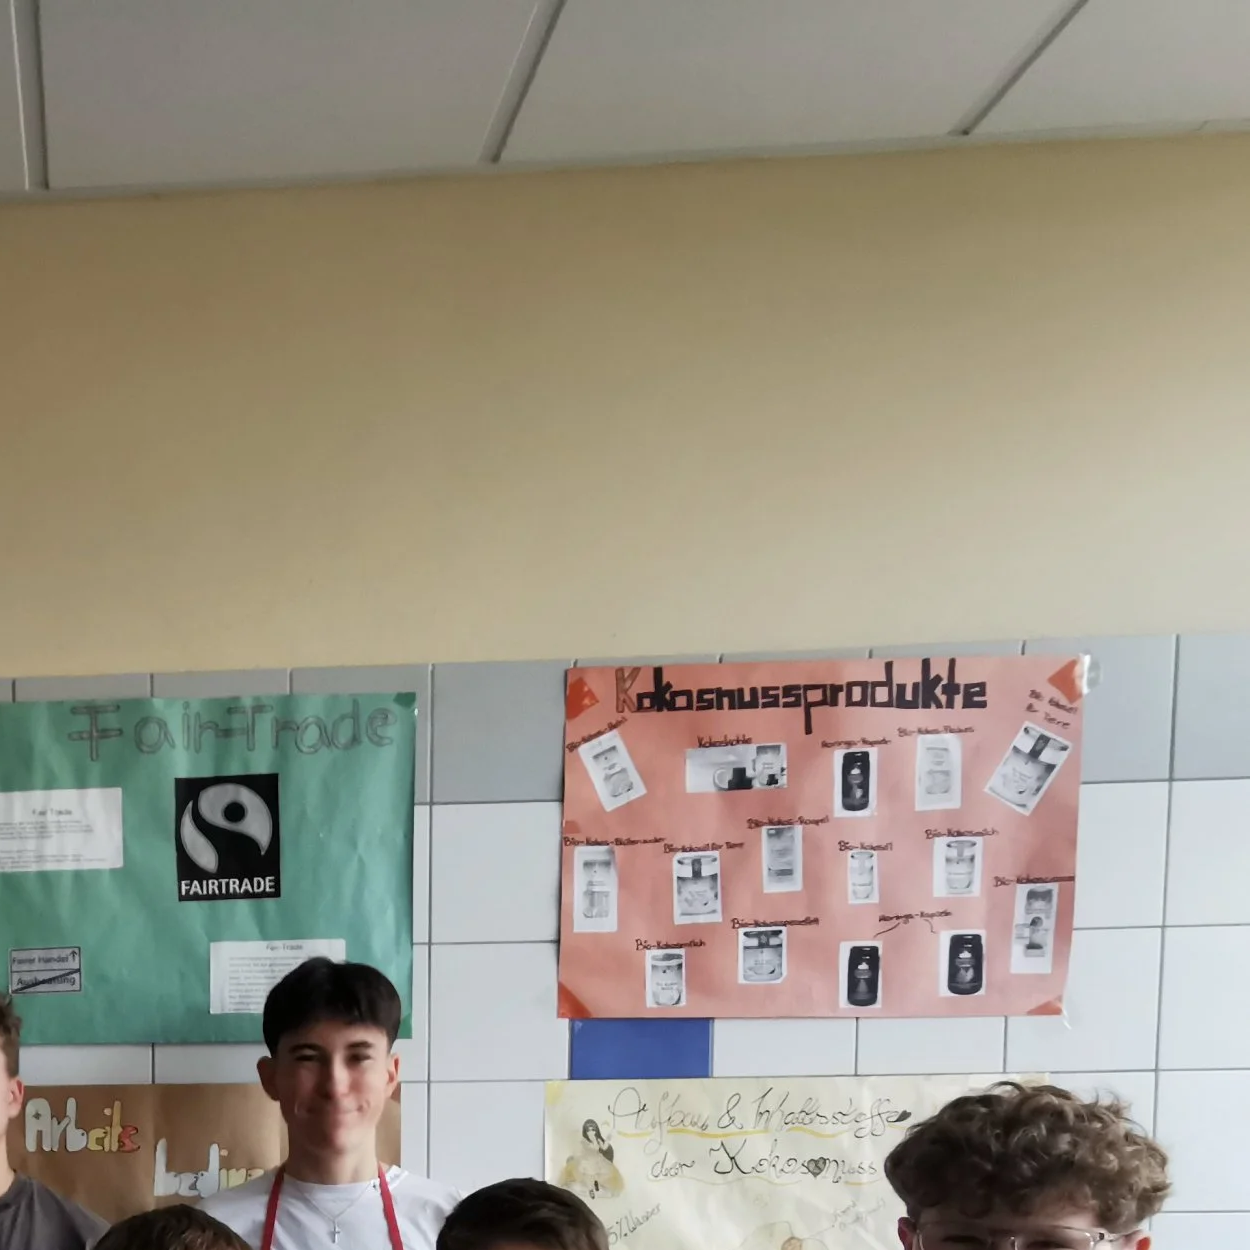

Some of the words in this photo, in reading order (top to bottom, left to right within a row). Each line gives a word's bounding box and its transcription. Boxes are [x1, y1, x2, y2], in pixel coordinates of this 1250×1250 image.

[614, 658, 988, 735] Kokosnussprodukte
[181, 876, 276, 895] FAIRTRADE
[24, 1096, 142, 1154] Arbeits
